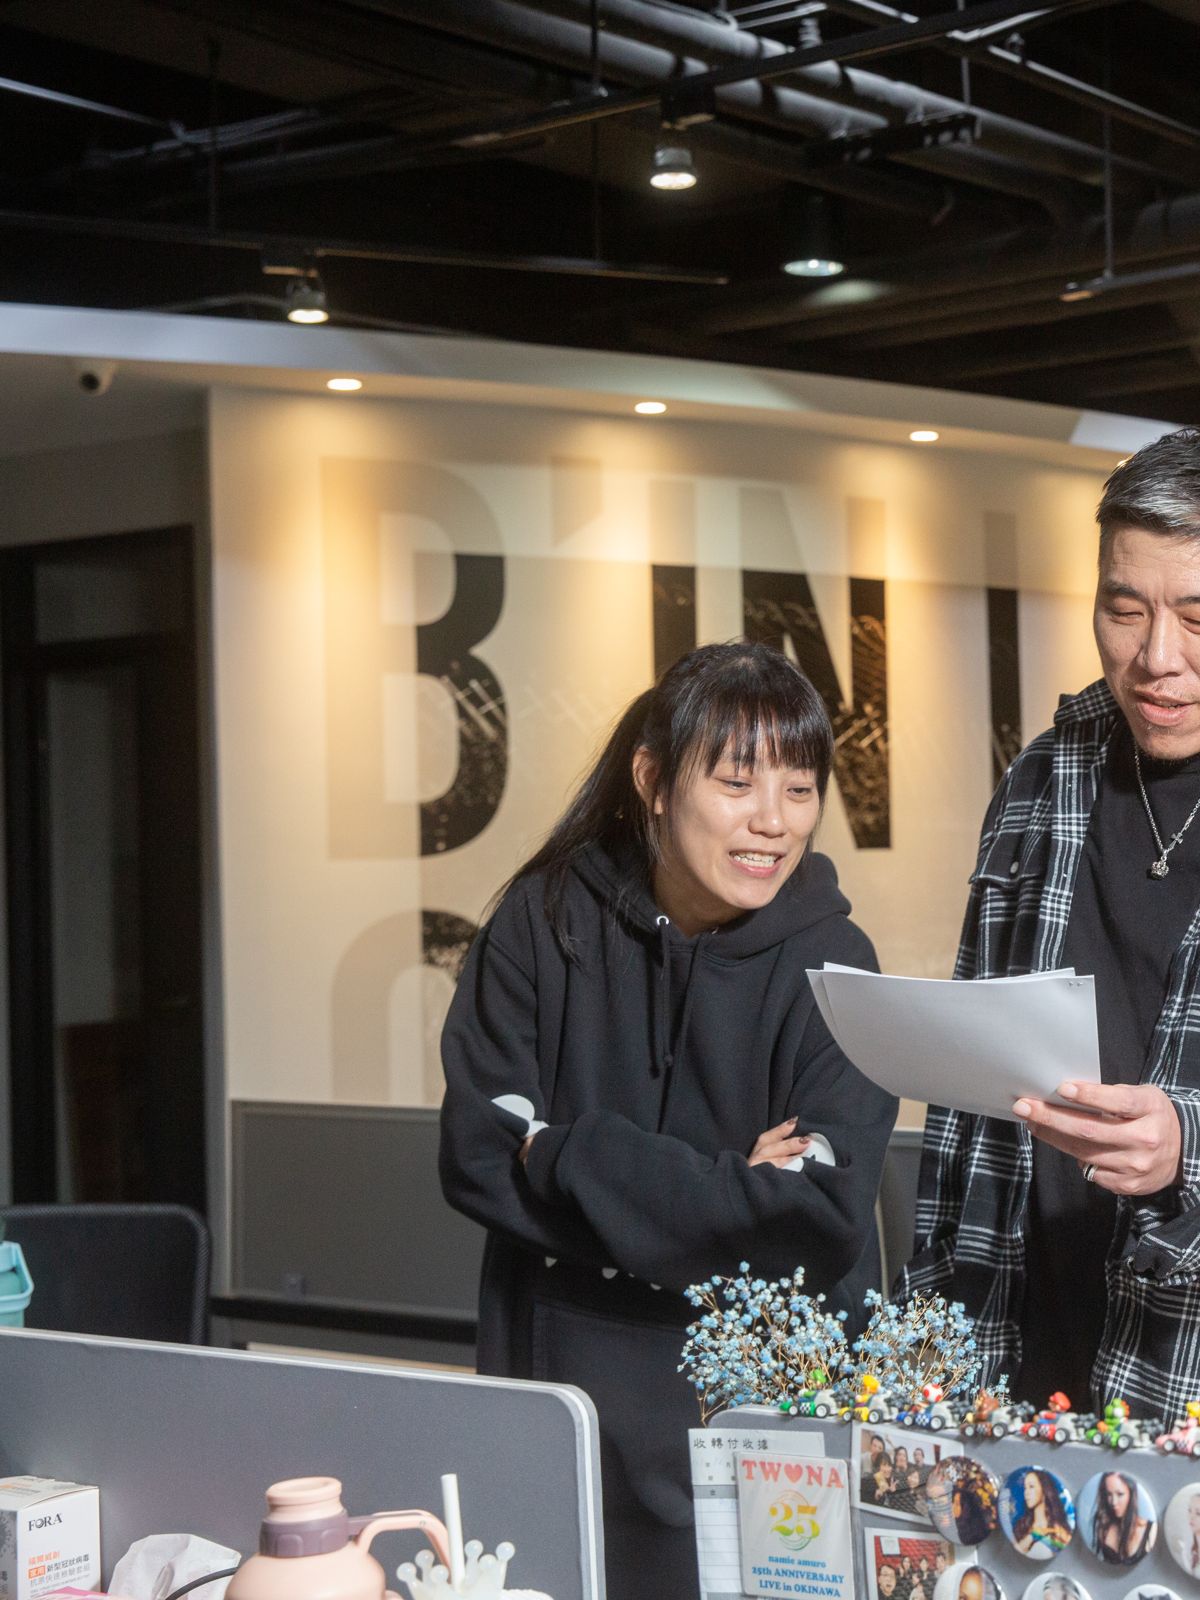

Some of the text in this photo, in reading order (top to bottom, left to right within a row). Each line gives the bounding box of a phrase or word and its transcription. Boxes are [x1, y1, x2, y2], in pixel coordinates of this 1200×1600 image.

[28, 1513, 63, 1531] FORA
[769, 1502, 820, 1539] 25
[768, 1555, 826, 1568] namie amuro
[752, 1566, 844, 1584] 25th ANNIVERSARY
[759, 1579, 841, 1597] LIVE in OKINAWA
